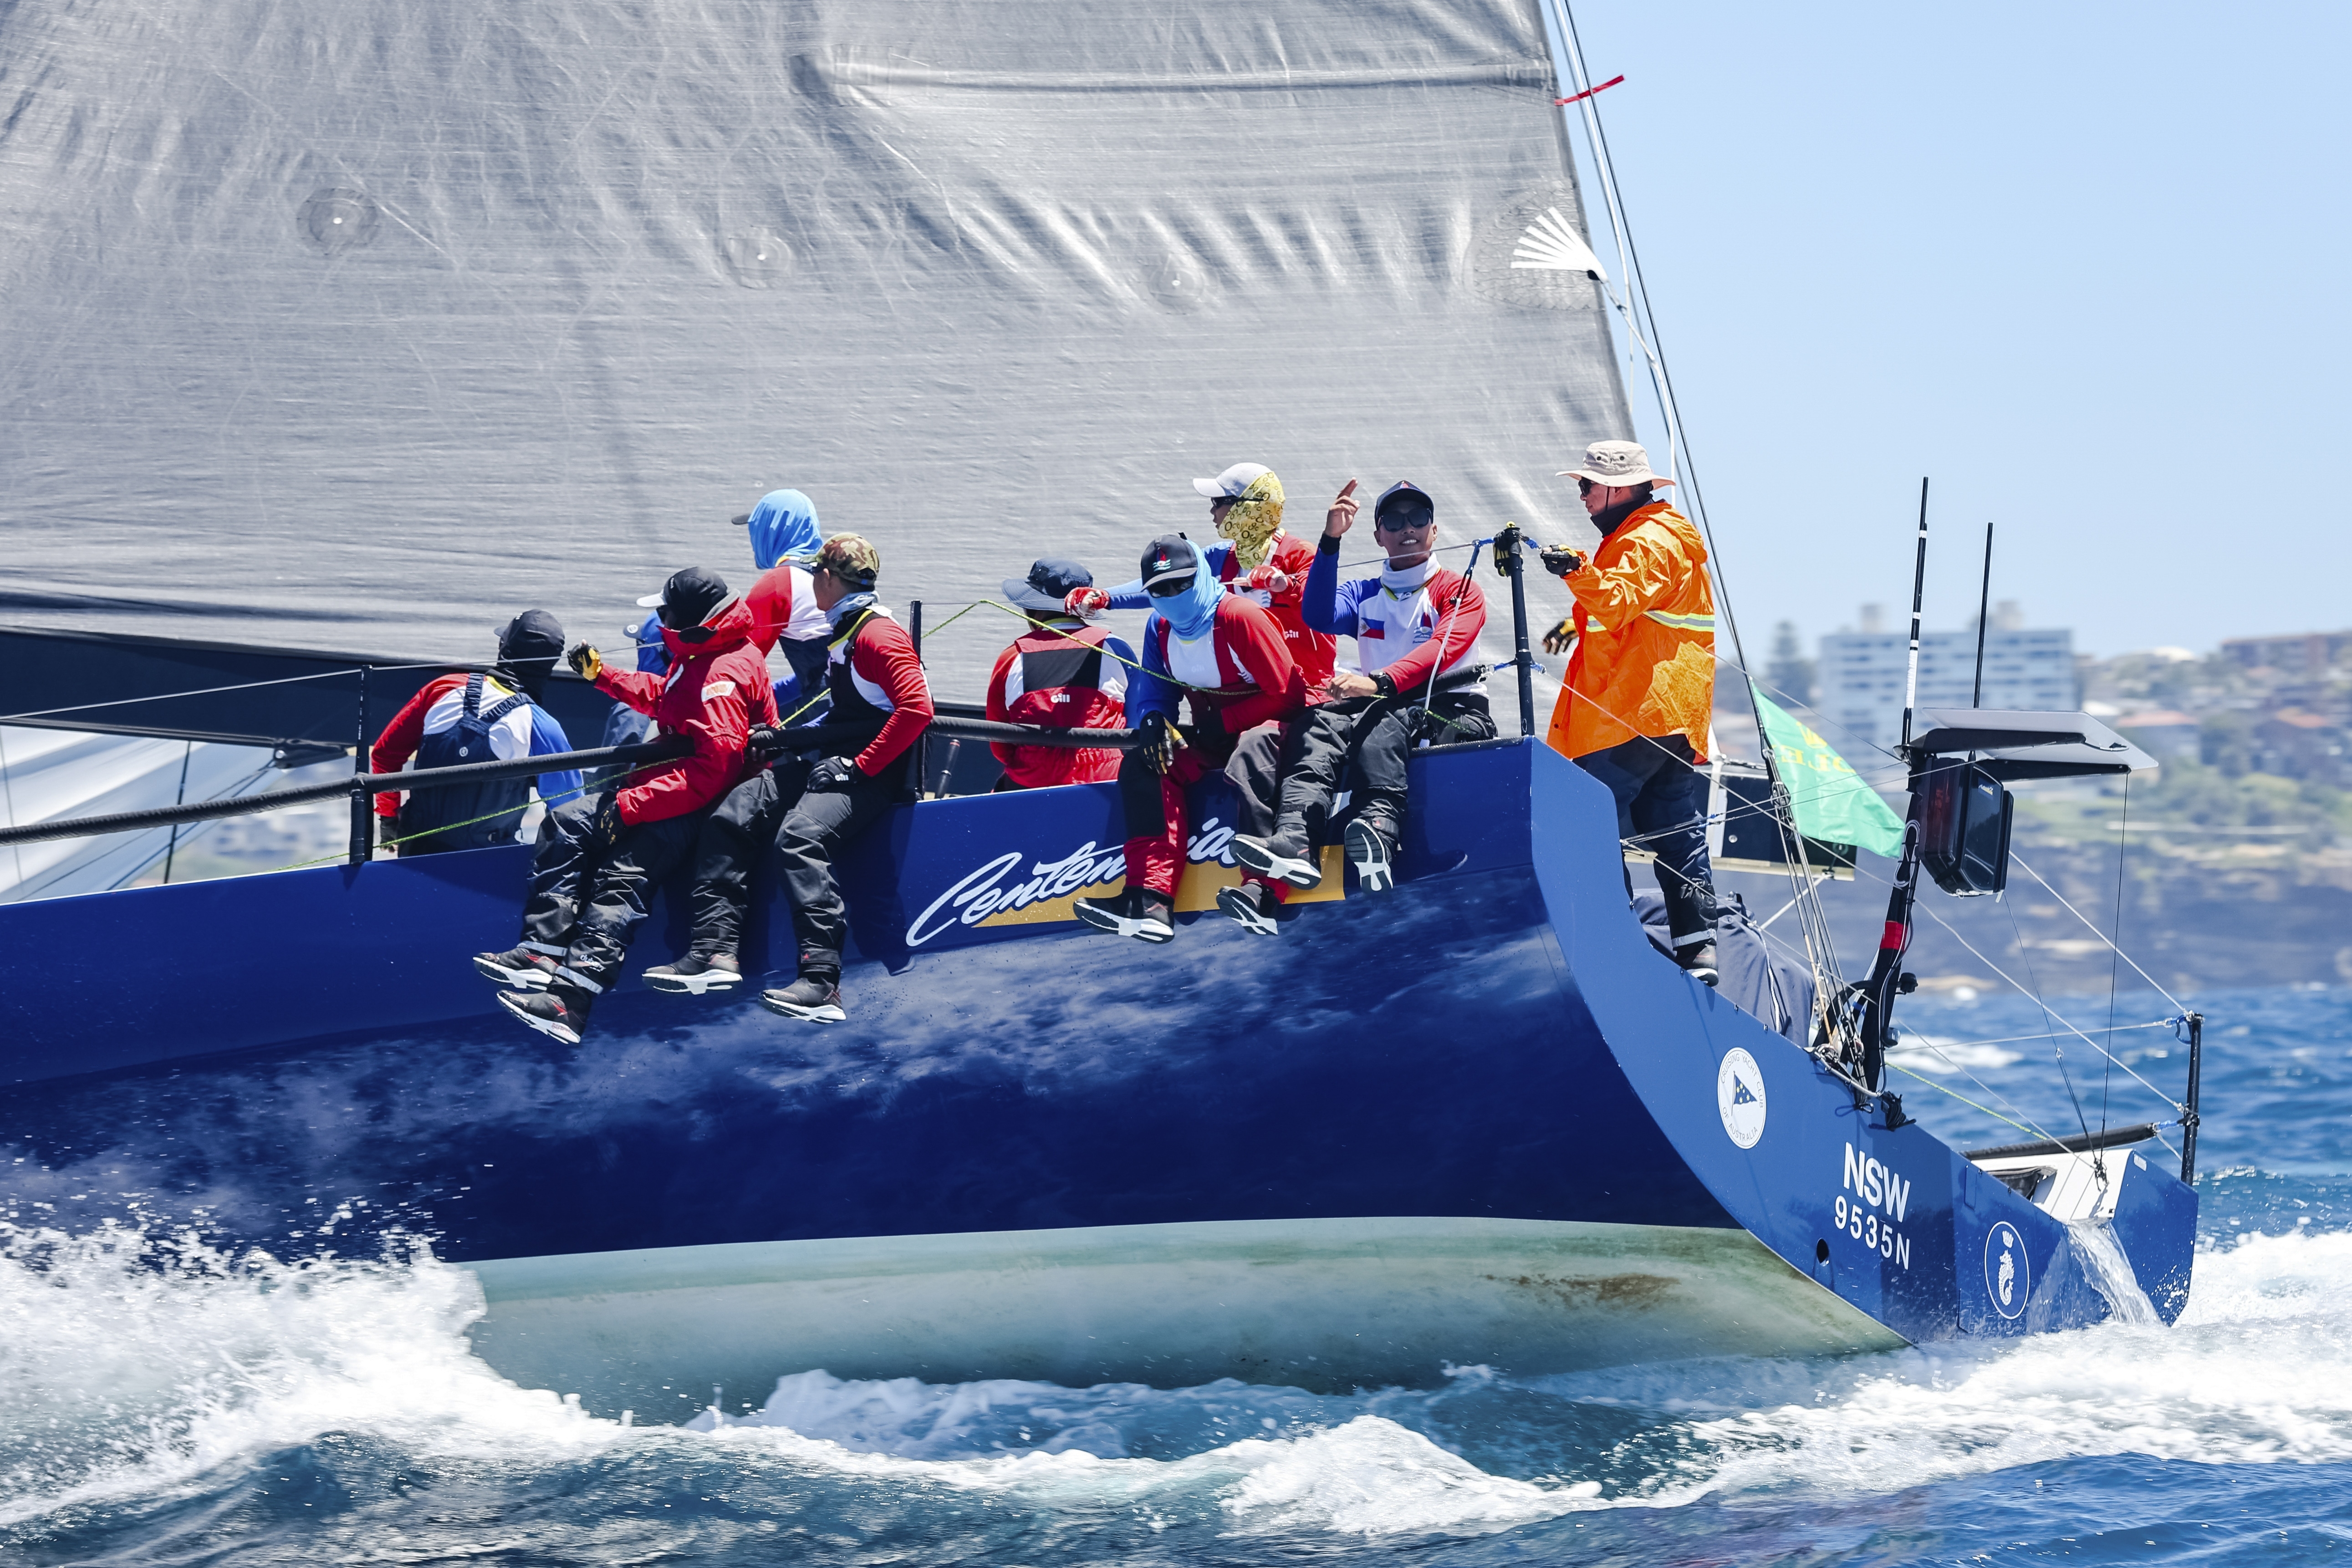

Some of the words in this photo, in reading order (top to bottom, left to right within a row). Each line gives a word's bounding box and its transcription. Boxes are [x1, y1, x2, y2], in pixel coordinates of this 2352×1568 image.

[1284, 630, 1299, 638] Gill
[1051, 692, 1070, 703] Gill
[835, 773, 849, 781] Gill
[1720, 1053, 1740, 1084] CRUISING
[1742, 1054, 1757, 1077] YACHT
[1722, 1106, 1730, 1120] OF
[1728, 1123, 1758, 1142] AUSTRALIA
[1843, 1141, 1910, 1223] NSW
[1835, 1195, 1910, 1270] 9535N
